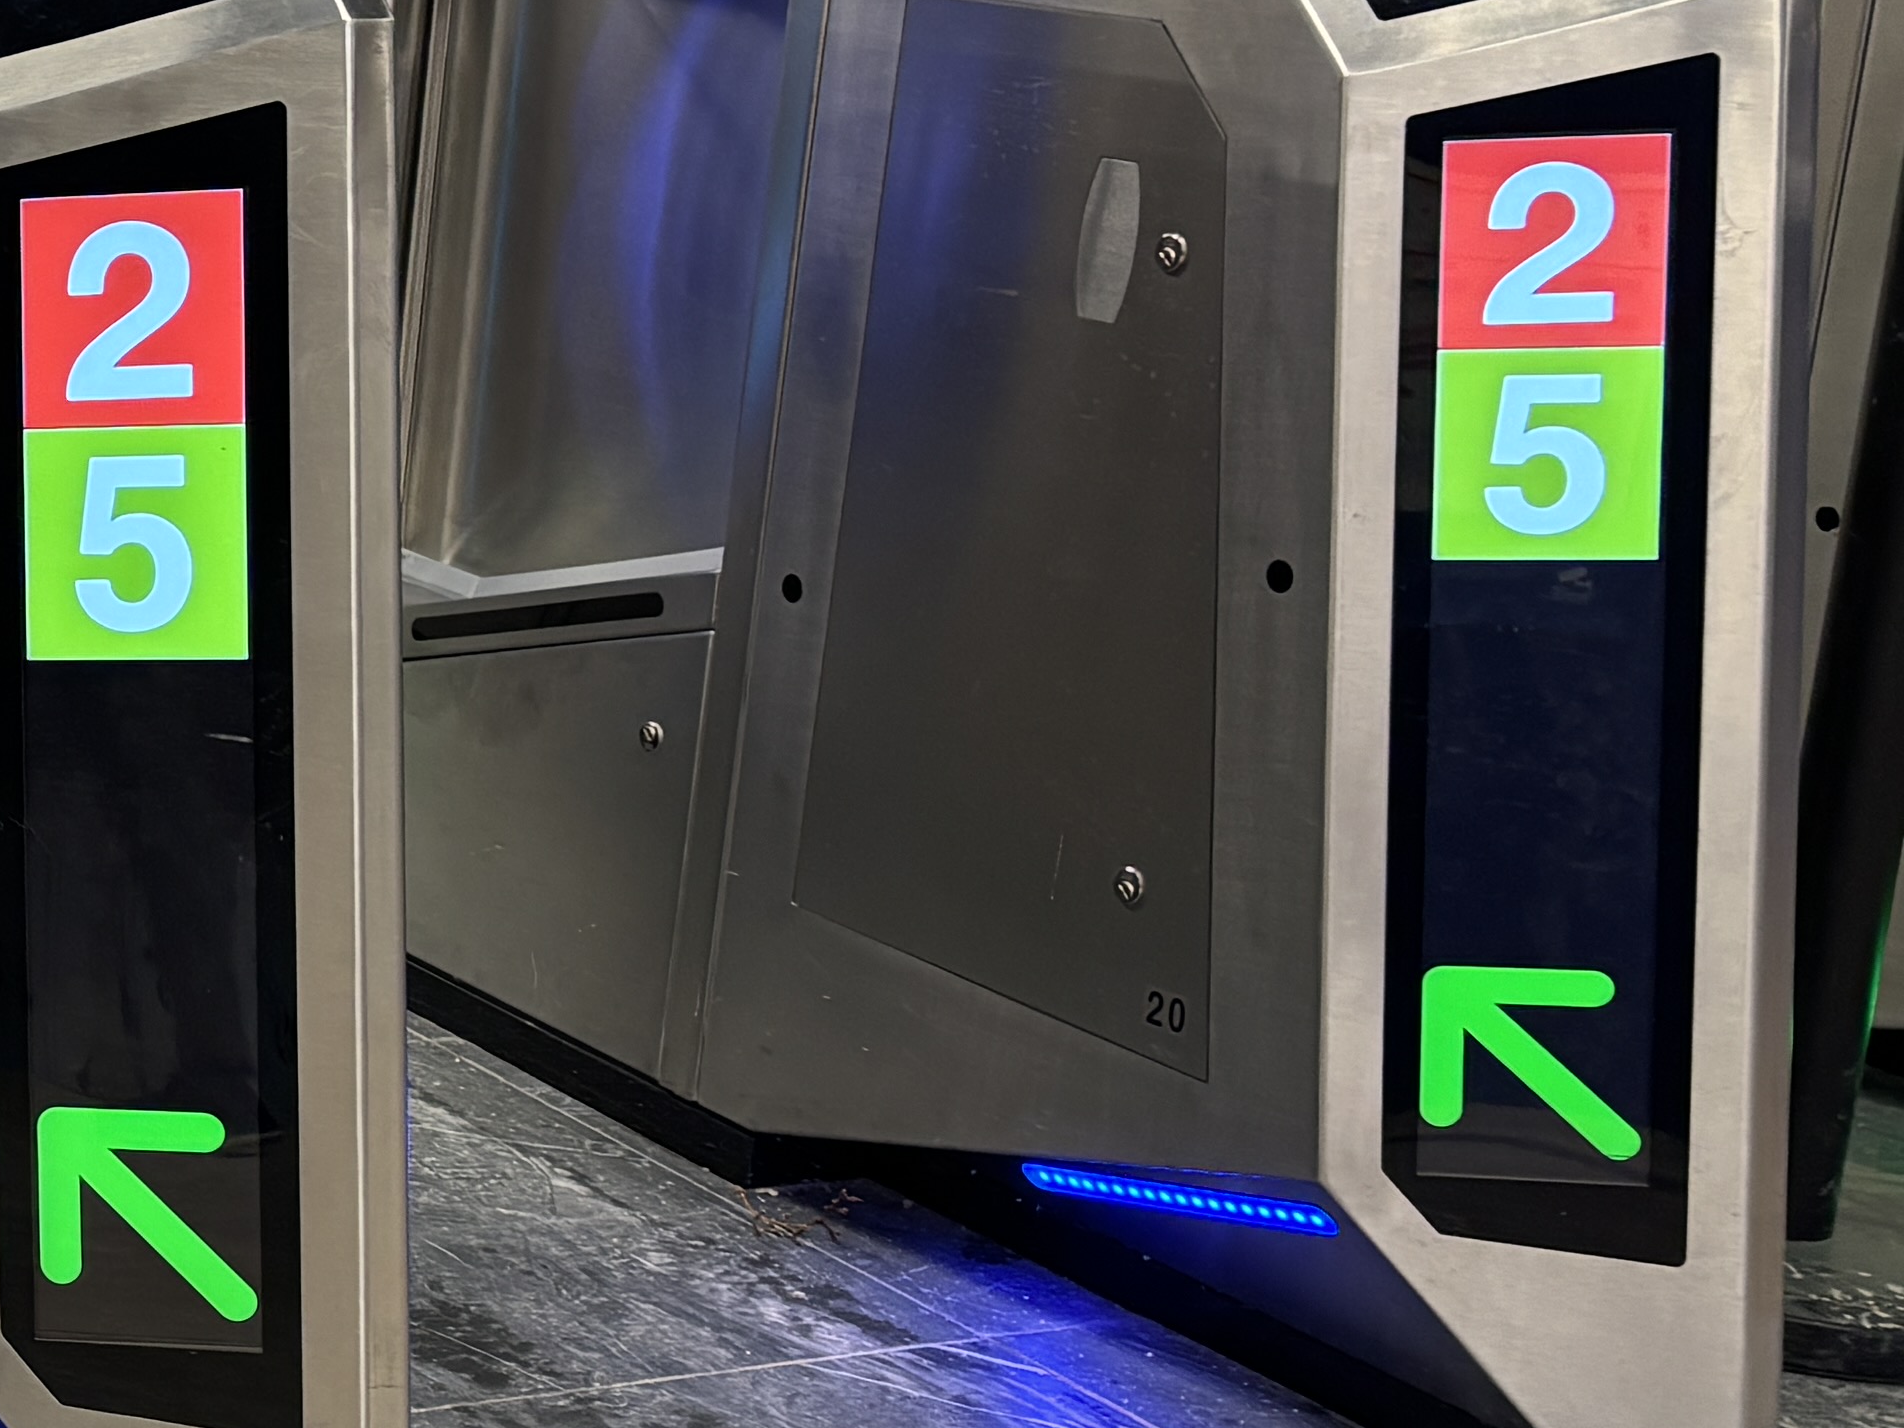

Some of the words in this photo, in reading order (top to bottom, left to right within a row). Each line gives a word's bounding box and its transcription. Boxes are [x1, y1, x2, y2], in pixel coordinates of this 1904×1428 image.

[65, 219, 194, 402] 2
[1481, 160, 1615, 326] 2
[1482, 372, 1607, 536] 5
[73, 453, 194, 633] 5
[1145, 990, 1186, 1033] 20
